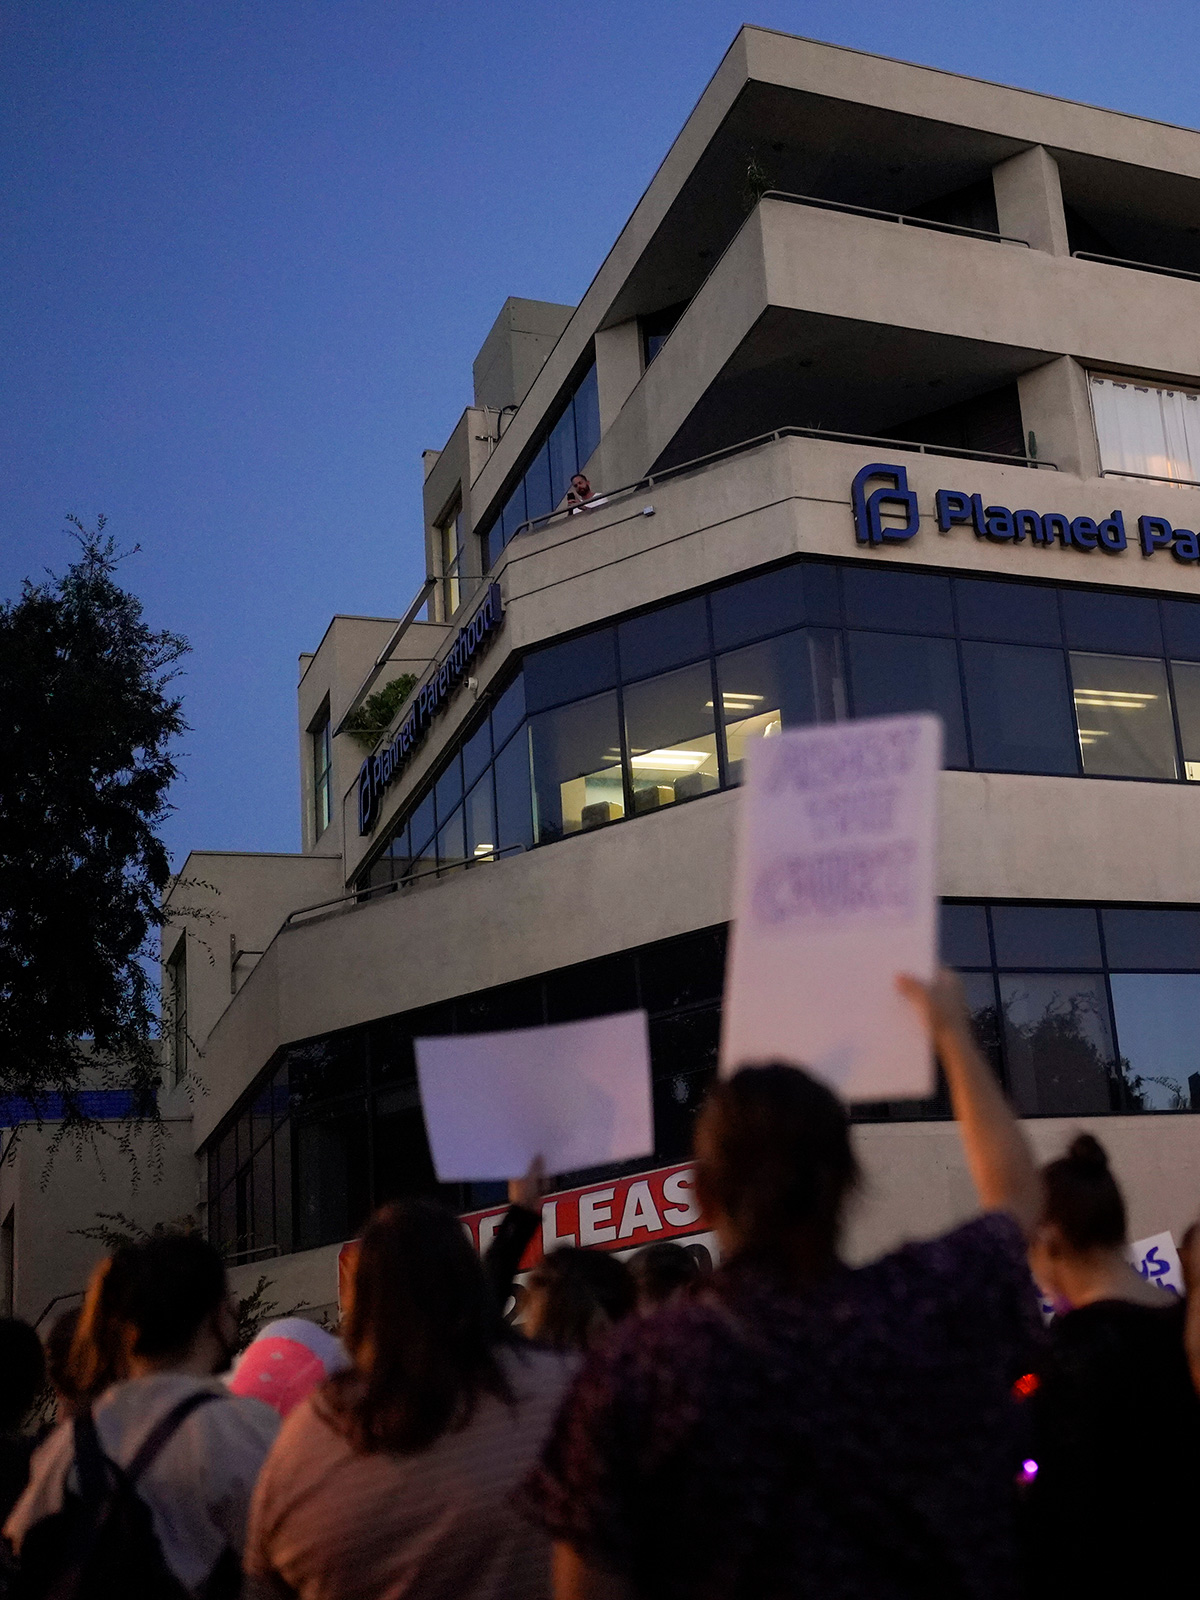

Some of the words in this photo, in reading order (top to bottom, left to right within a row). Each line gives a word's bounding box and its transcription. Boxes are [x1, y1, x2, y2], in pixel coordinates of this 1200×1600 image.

[935, 489, 1127, 553] Planned
[418, 583, 503, 727] Parenthood
[541, 1168, 702, 1256] LEAS
